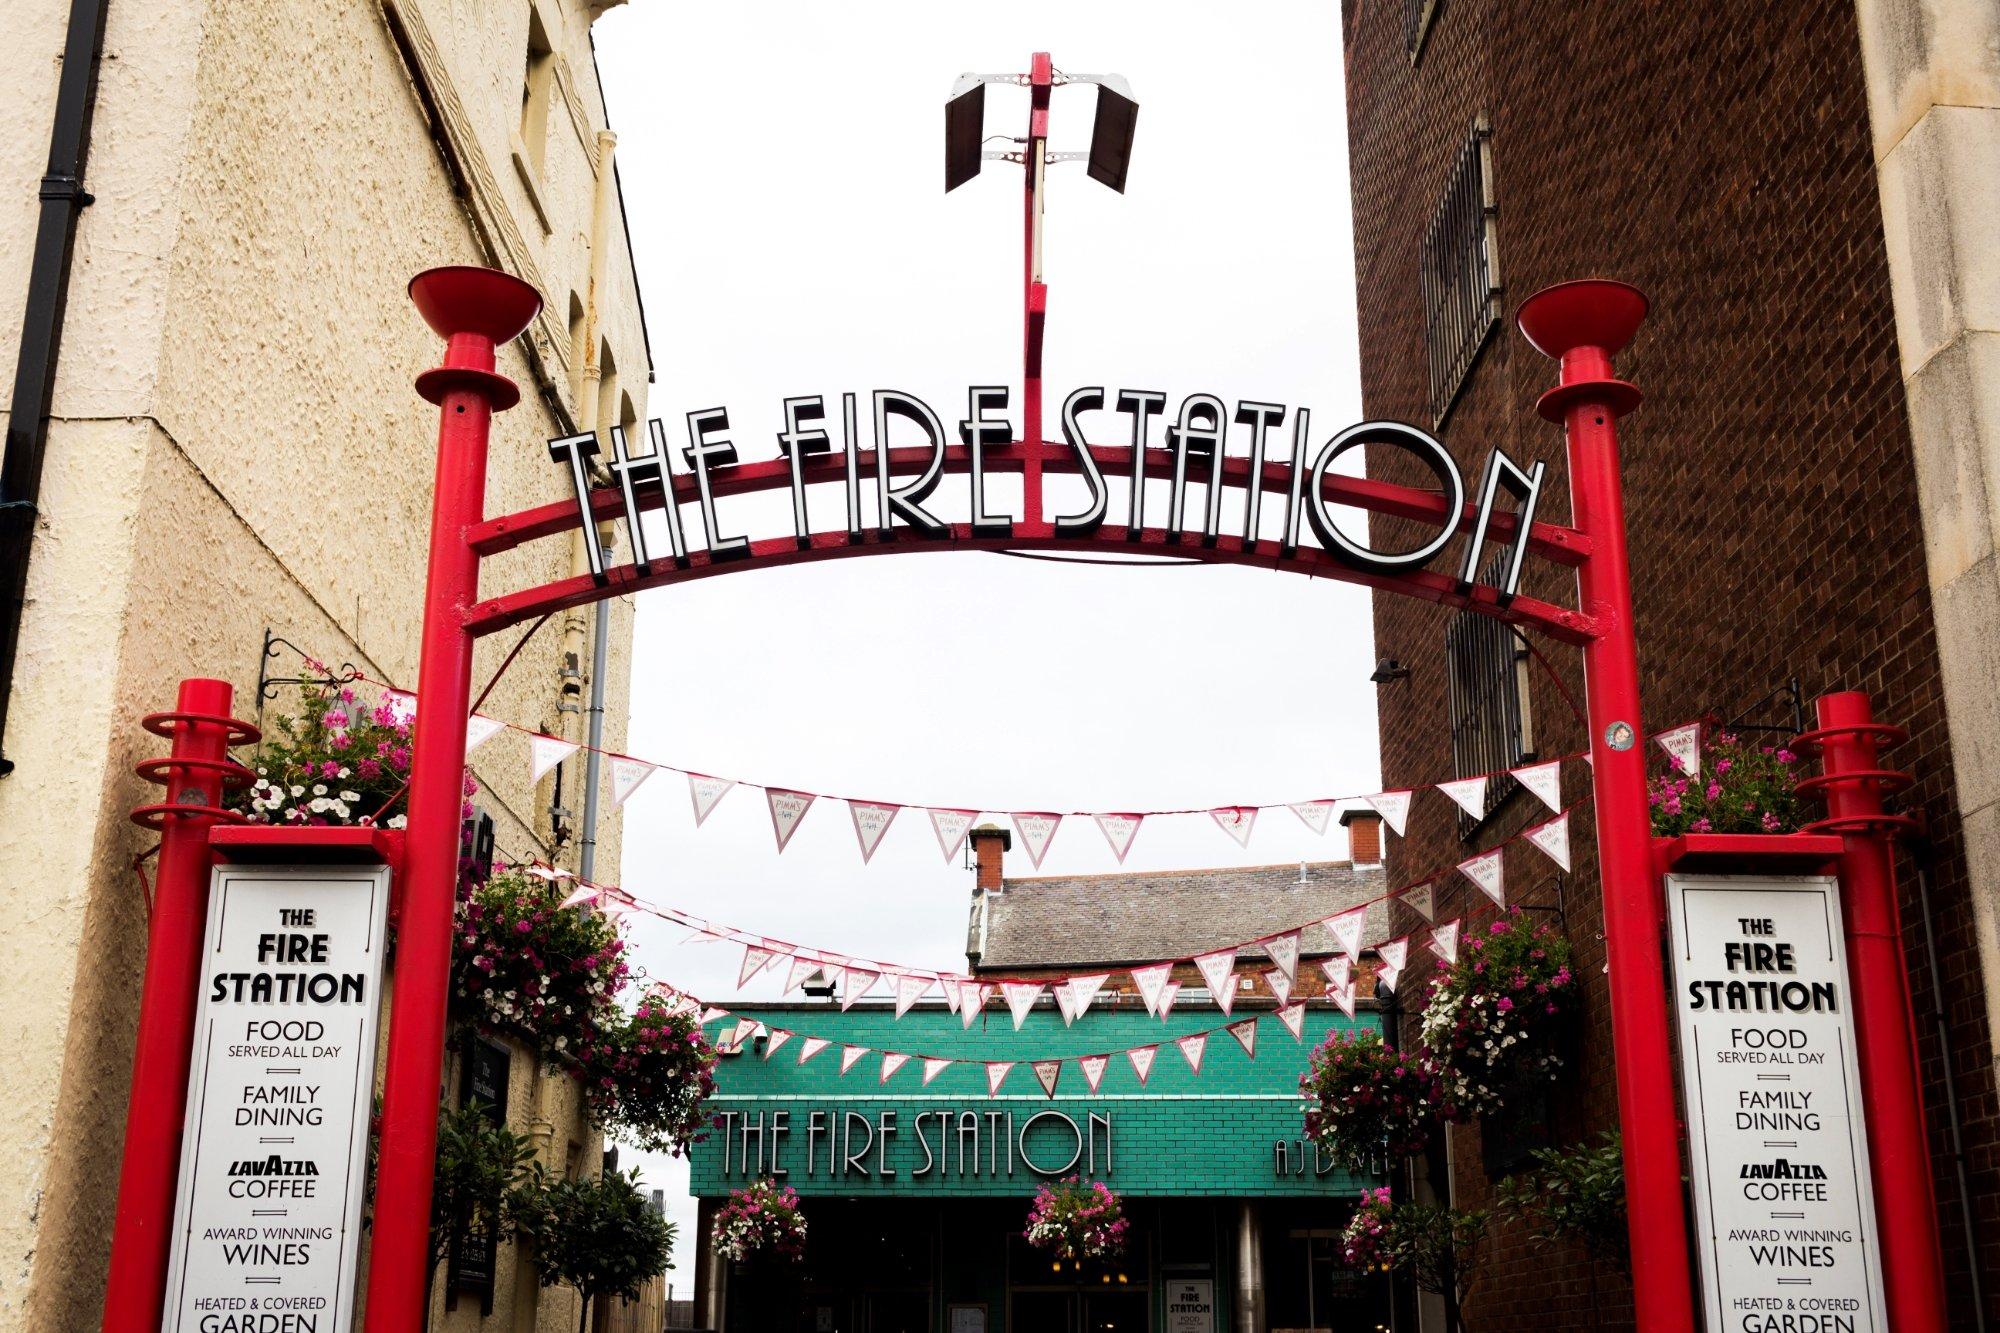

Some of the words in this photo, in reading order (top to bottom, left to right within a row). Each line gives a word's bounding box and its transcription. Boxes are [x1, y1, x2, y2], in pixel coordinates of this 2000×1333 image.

[549, 407, 752, 583] THE
[777, 386, 1012, 548] FIRE
[1055, 386, 1545, 605] STATION
[1668, 734, 1693, 750] PIMM'S
[775, 799, 801, 811] PIMM'S
[859, 811, 885, 823] PIMM'S
[1472, 859, 1497, 876] PIMM'S
[1406, 886, 1430, 903] PIMM'S
[279, 908, 316, 927] THE
[1738, 917, 1775, 936] THE
[257, 933, 330, 964] FIRE
[1724, 942, 1795, 972] FIRE
[211, 973, 366, 1004] STATION
[1688, 980, 1838, 1012] STATION
[246, 1020, 324, 1042] FOOD
[1731, 1028, 1808, 1049] FOOD
[228, 1046, 280, 1058] SERVED
[282, 1046, 308, 1058] ALL
[312, 1046, 342, 1058] DAY
[1717, 1051, 1767, 1064] SERVED
[1769, 1052, 1794, 1064] ALL
[1798, 1052, 1825, 1065] DAY
[243, 1085, 321, 1104] FAMILY
[1739, 1090, 1812, 1109] FAMILY
[235, 1107, 323, 1126] DINING
[1735, 1112, 1820, 1131] DINING
[720, 1110, 789, 1174] THE
[807, 1110, 897, 1175] FIRE
[912, 1109, 1113, 1175] STATION
[227, 1154, 320, 1176] LAVAZZA
[1739, 1158, 1828, 1180] LAVAZZA
[228, 1179, 316, 1198] COFFEE
[1743, 1182, 1828, 1201] COFFEE
[203, 1227, 258, 1240] AWARD
[262, 1227, 333, 1240] WINNING
[1728, 1229, 1780, 1242] AWARD
[1784, 1229, 1853, 1243] WINNING
[222, 1243, 310, 1266] WINES
[1748, 1245, 1835, 1268] WINES
[194, 1297, 246, 1310] HEATED
[250, 1297, 259, 1310] &
[263, 1297, 326, 1310] COVERED
[1180, 1292, 1200, 1302] FIRE
[1733, 1297, 1783, 1310] HEATED
[1787, 1298, 1796, 1310] &
[1799, 1298, 1860, 1311] COVERED
[1169, 1303, 1211, 1314] STATION
[200, 1313, 317, 1333] GARDEN
[1742, 1313, 1855, 1333] GARDEN
